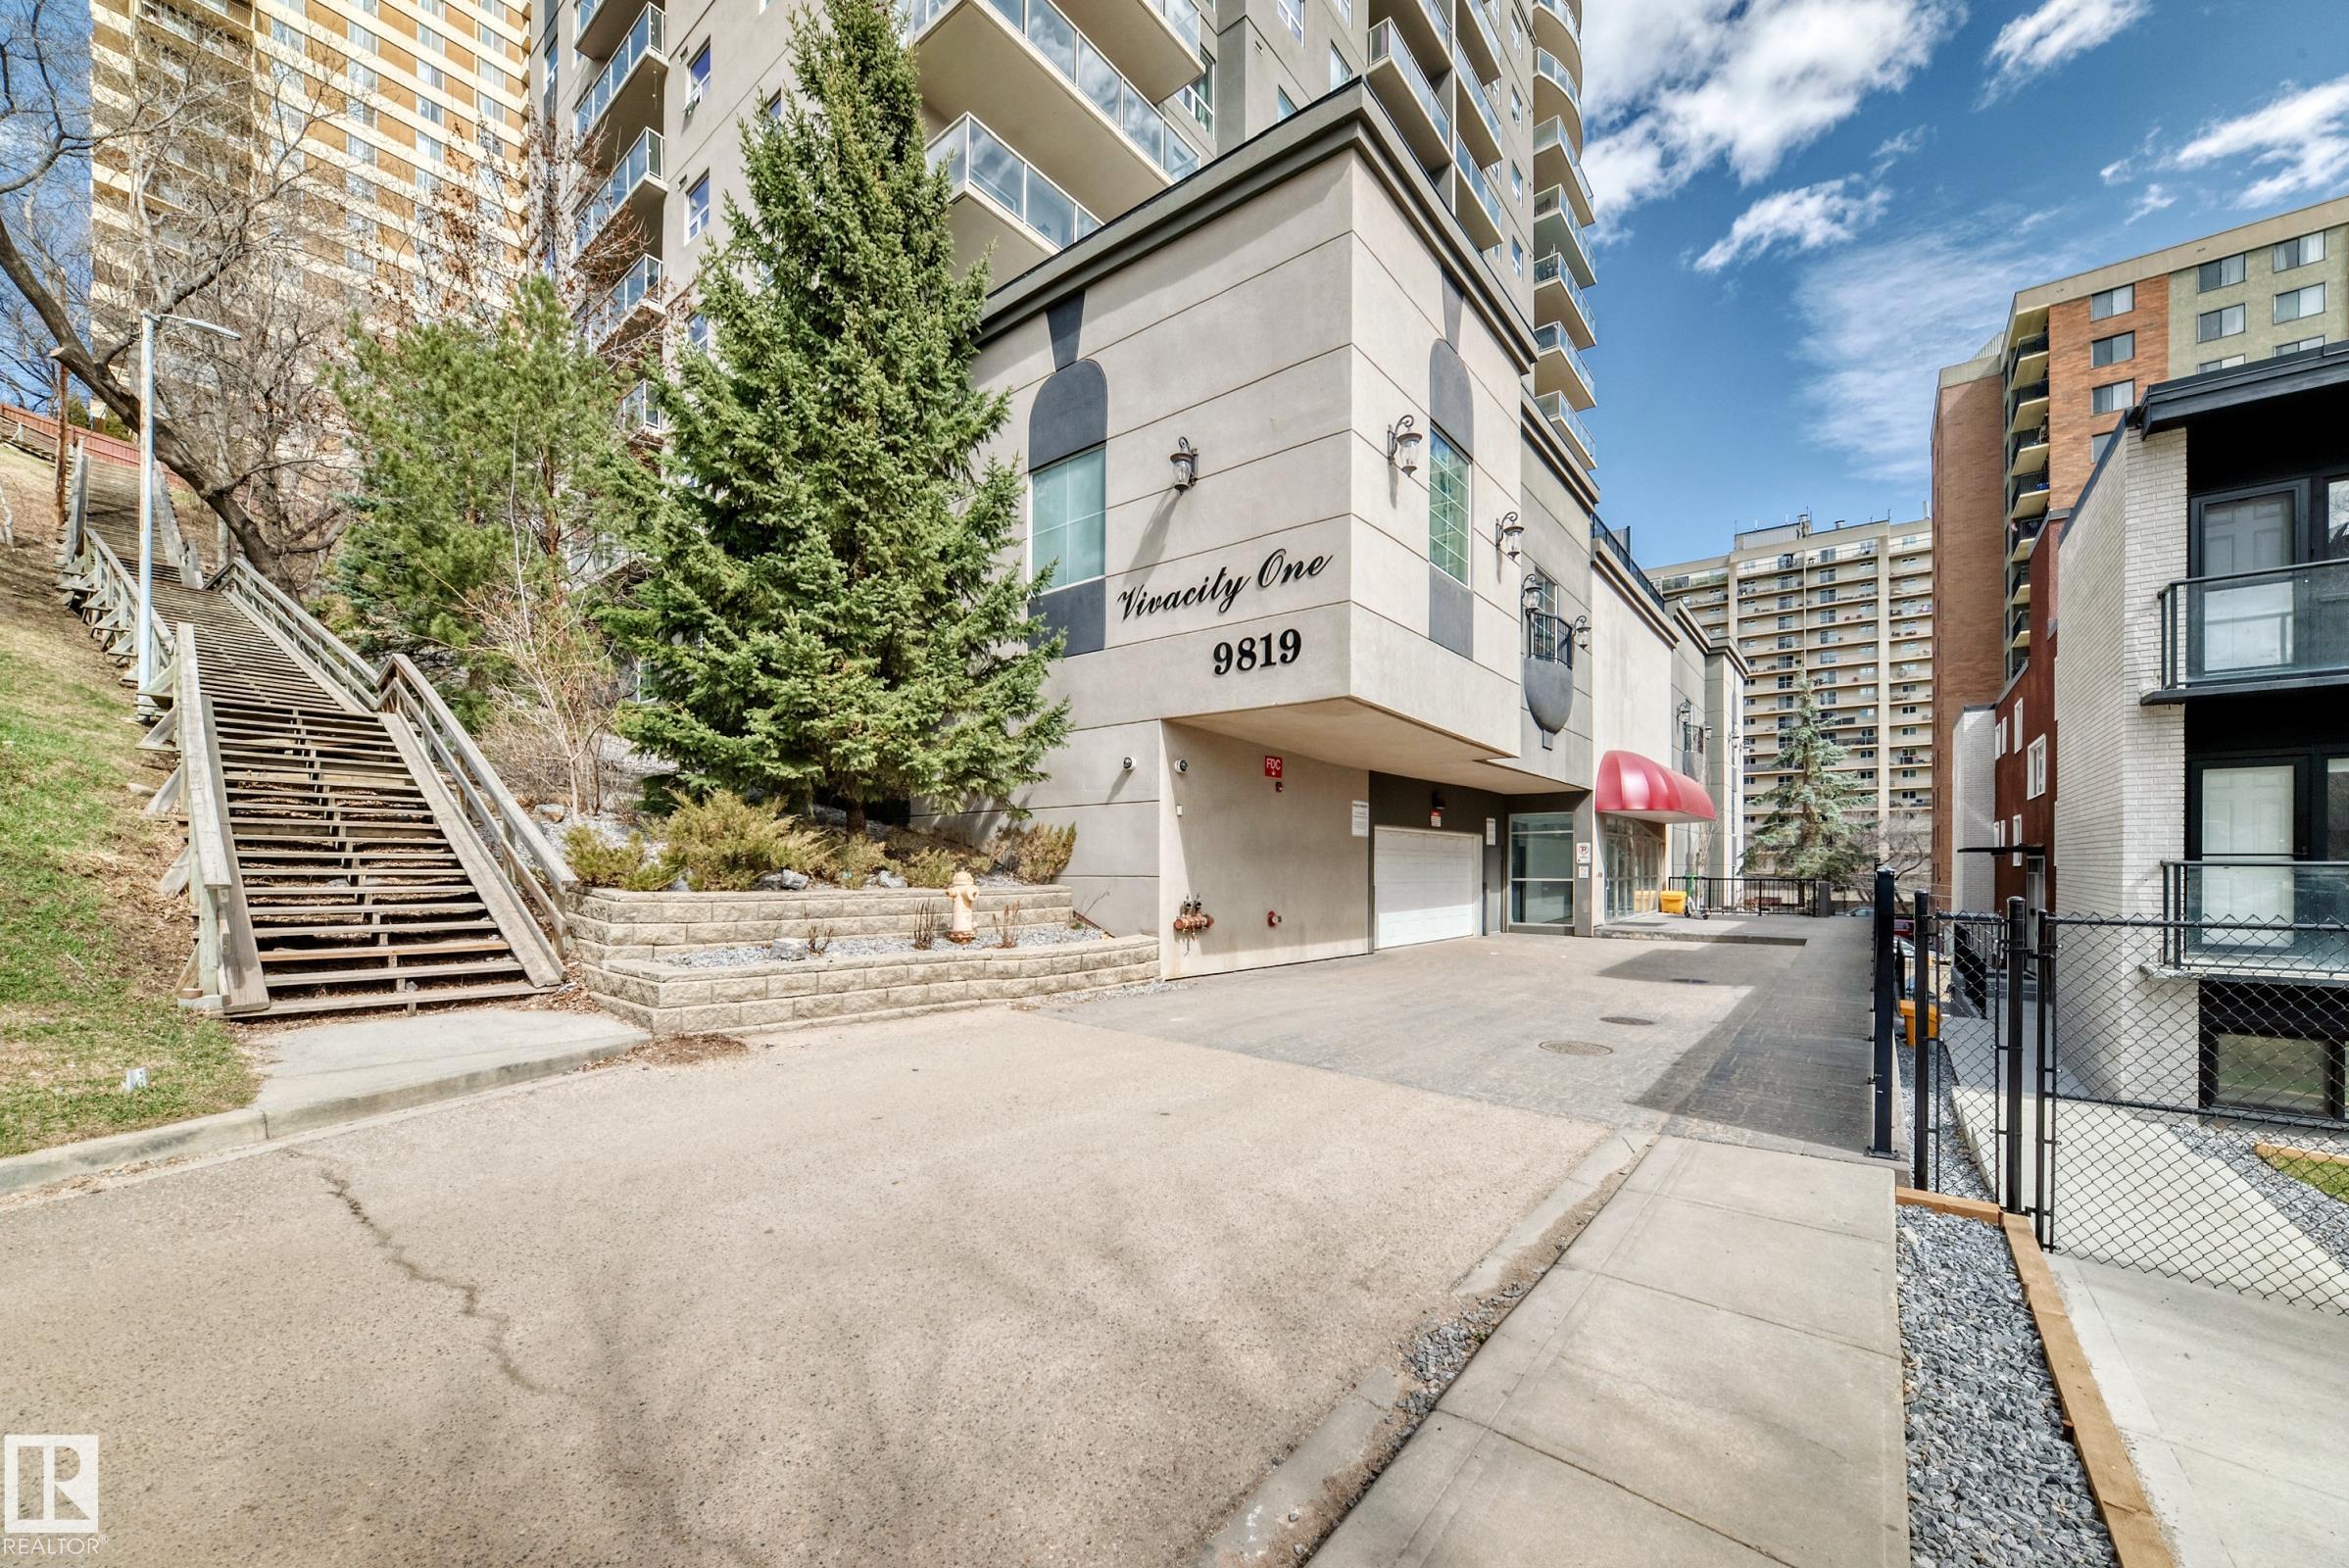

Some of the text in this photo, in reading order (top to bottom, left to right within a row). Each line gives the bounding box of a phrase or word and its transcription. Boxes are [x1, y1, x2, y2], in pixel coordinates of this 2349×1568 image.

[1117, 548, 1333, 622] Vivacity One
[1213, 628, 1301, 675] 9819
[1266, 758, 1281, 770] FDC
